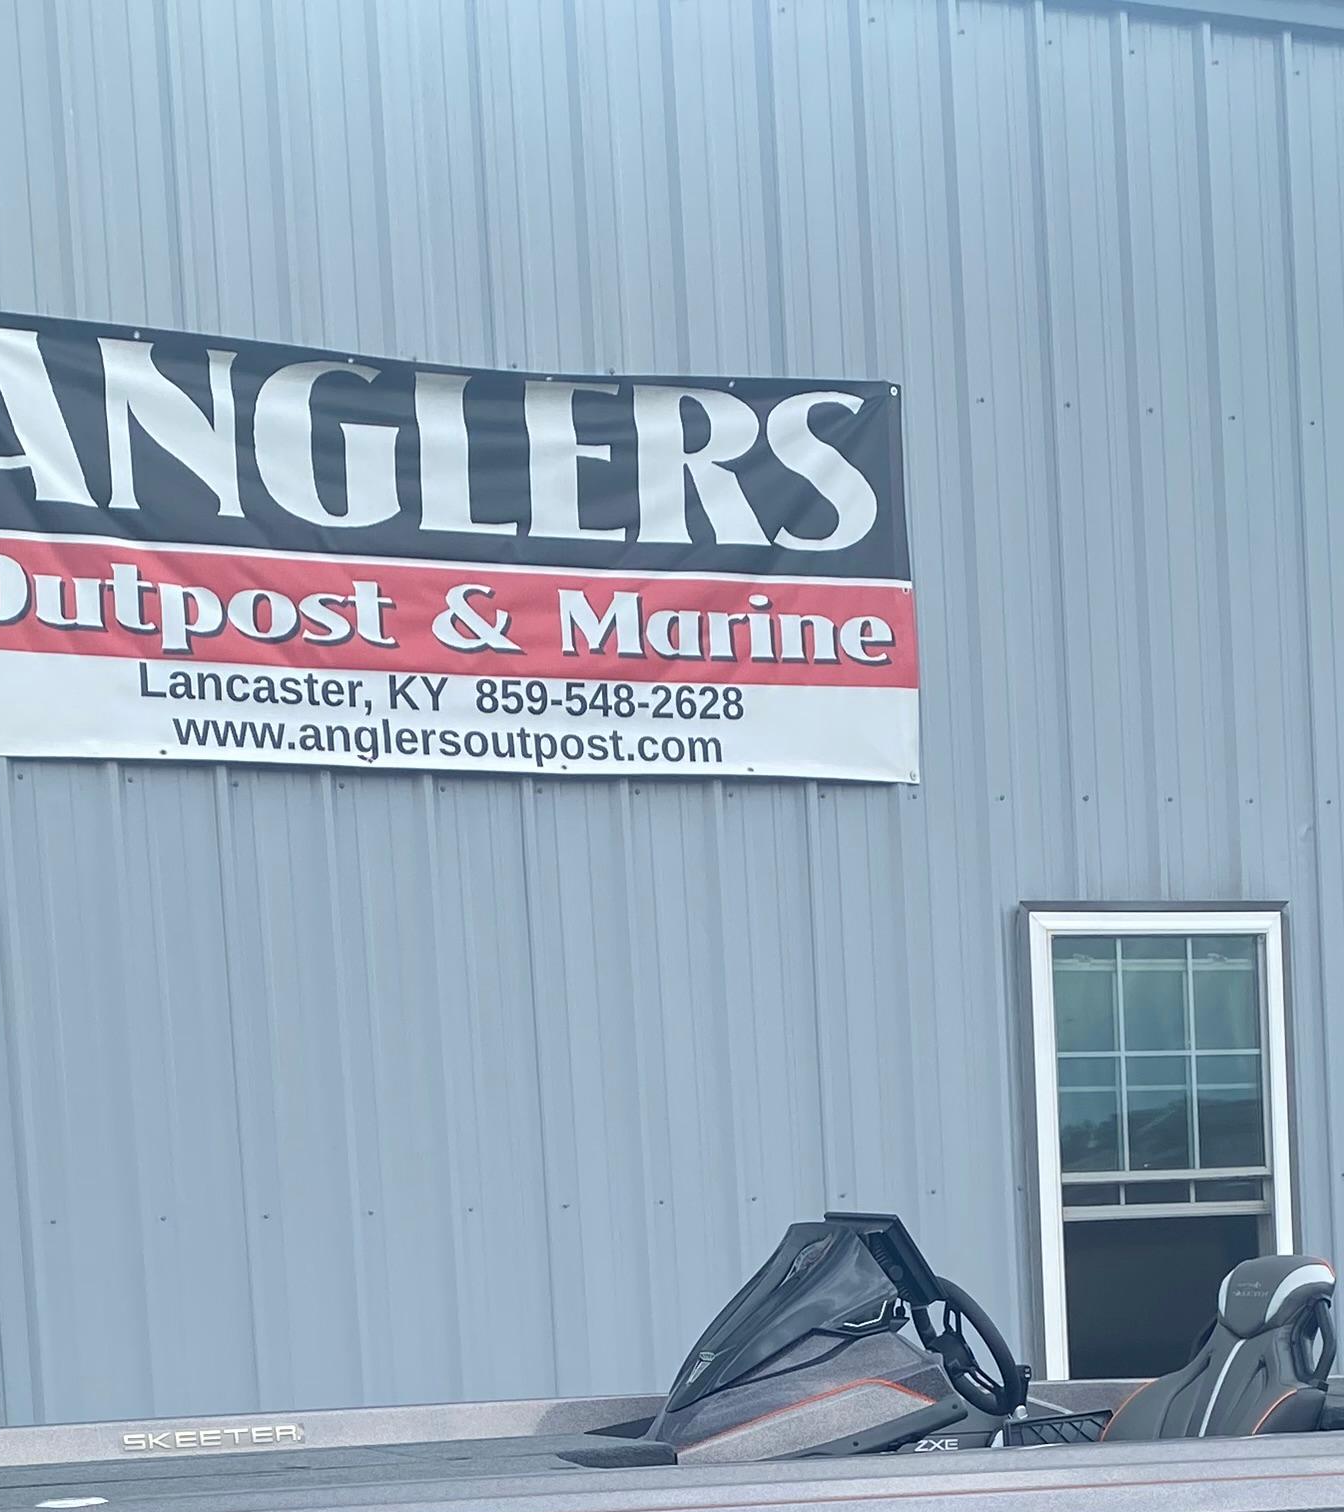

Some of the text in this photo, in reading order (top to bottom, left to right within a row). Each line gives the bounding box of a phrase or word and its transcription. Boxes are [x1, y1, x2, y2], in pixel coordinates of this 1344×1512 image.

[431, 583, 527, 655] &
[556, 588, 896, 666] Marine
[138, 661, 745, 720] Lancaster, KY 859-548-2628
[172, 717, 723, 768] www.anglersoutpost.com
[122, 1423, 304, 1451] SKEETER
[914, 1438, 959, 1452] ZXE
